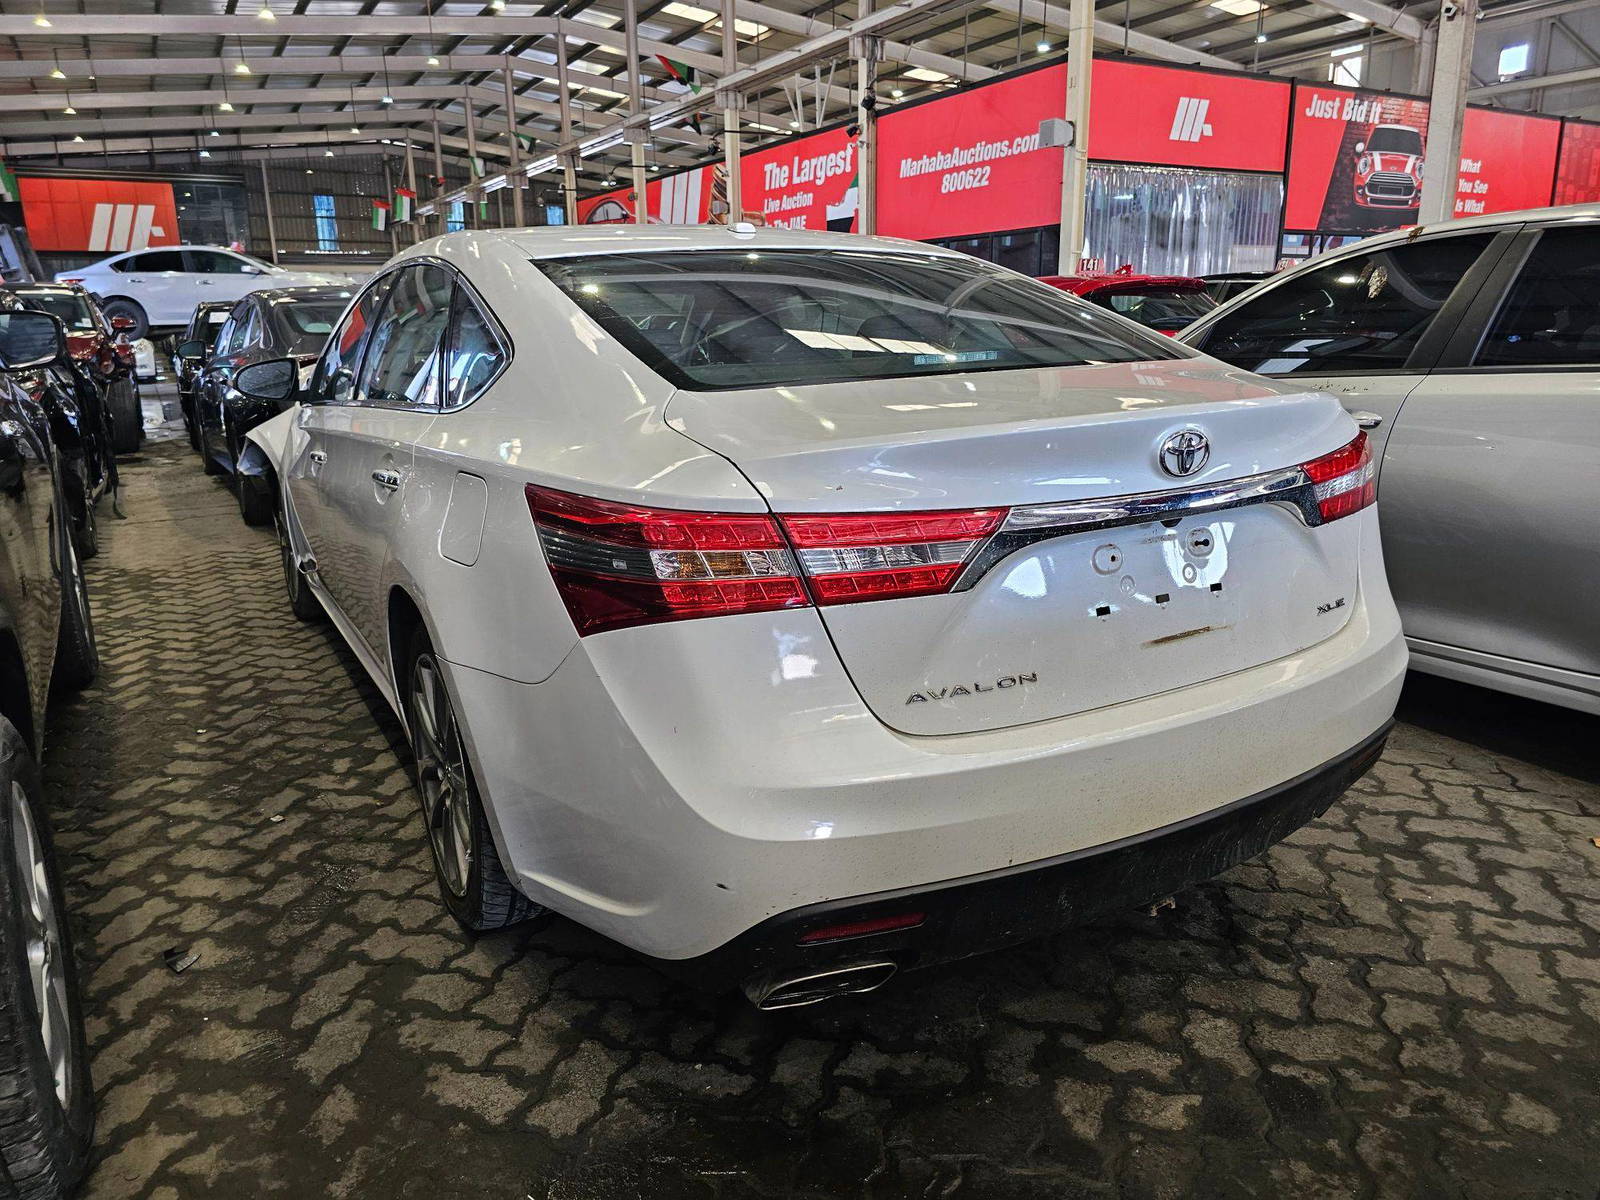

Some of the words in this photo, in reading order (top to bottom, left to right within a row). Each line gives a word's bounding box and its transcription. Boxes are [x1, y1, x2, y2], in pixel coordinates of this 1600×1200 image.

[1305, 94, 1340, 120] Just
[1341, 98, 1369, 122] Bid
[1368, 101, 1381, 125] It
[764, 162, 789, 190] The
[792, 142, 853, 185] Largest
[1460, 158, 1481, 173] What
[941, 166, 991, 194] 800622
[1458, 178, 1473, 193] You
[1473, 180, 1488, 194] See
[764, 198, 780, 213] Live
[781, 192, 813, 211] Auction
[1464, 199, 1485, 213] What
[1081, 258, 1098, 271] 141
[1316, 597, 1345, 616] XLE
[905, 671, 1038, 705] AVALON
